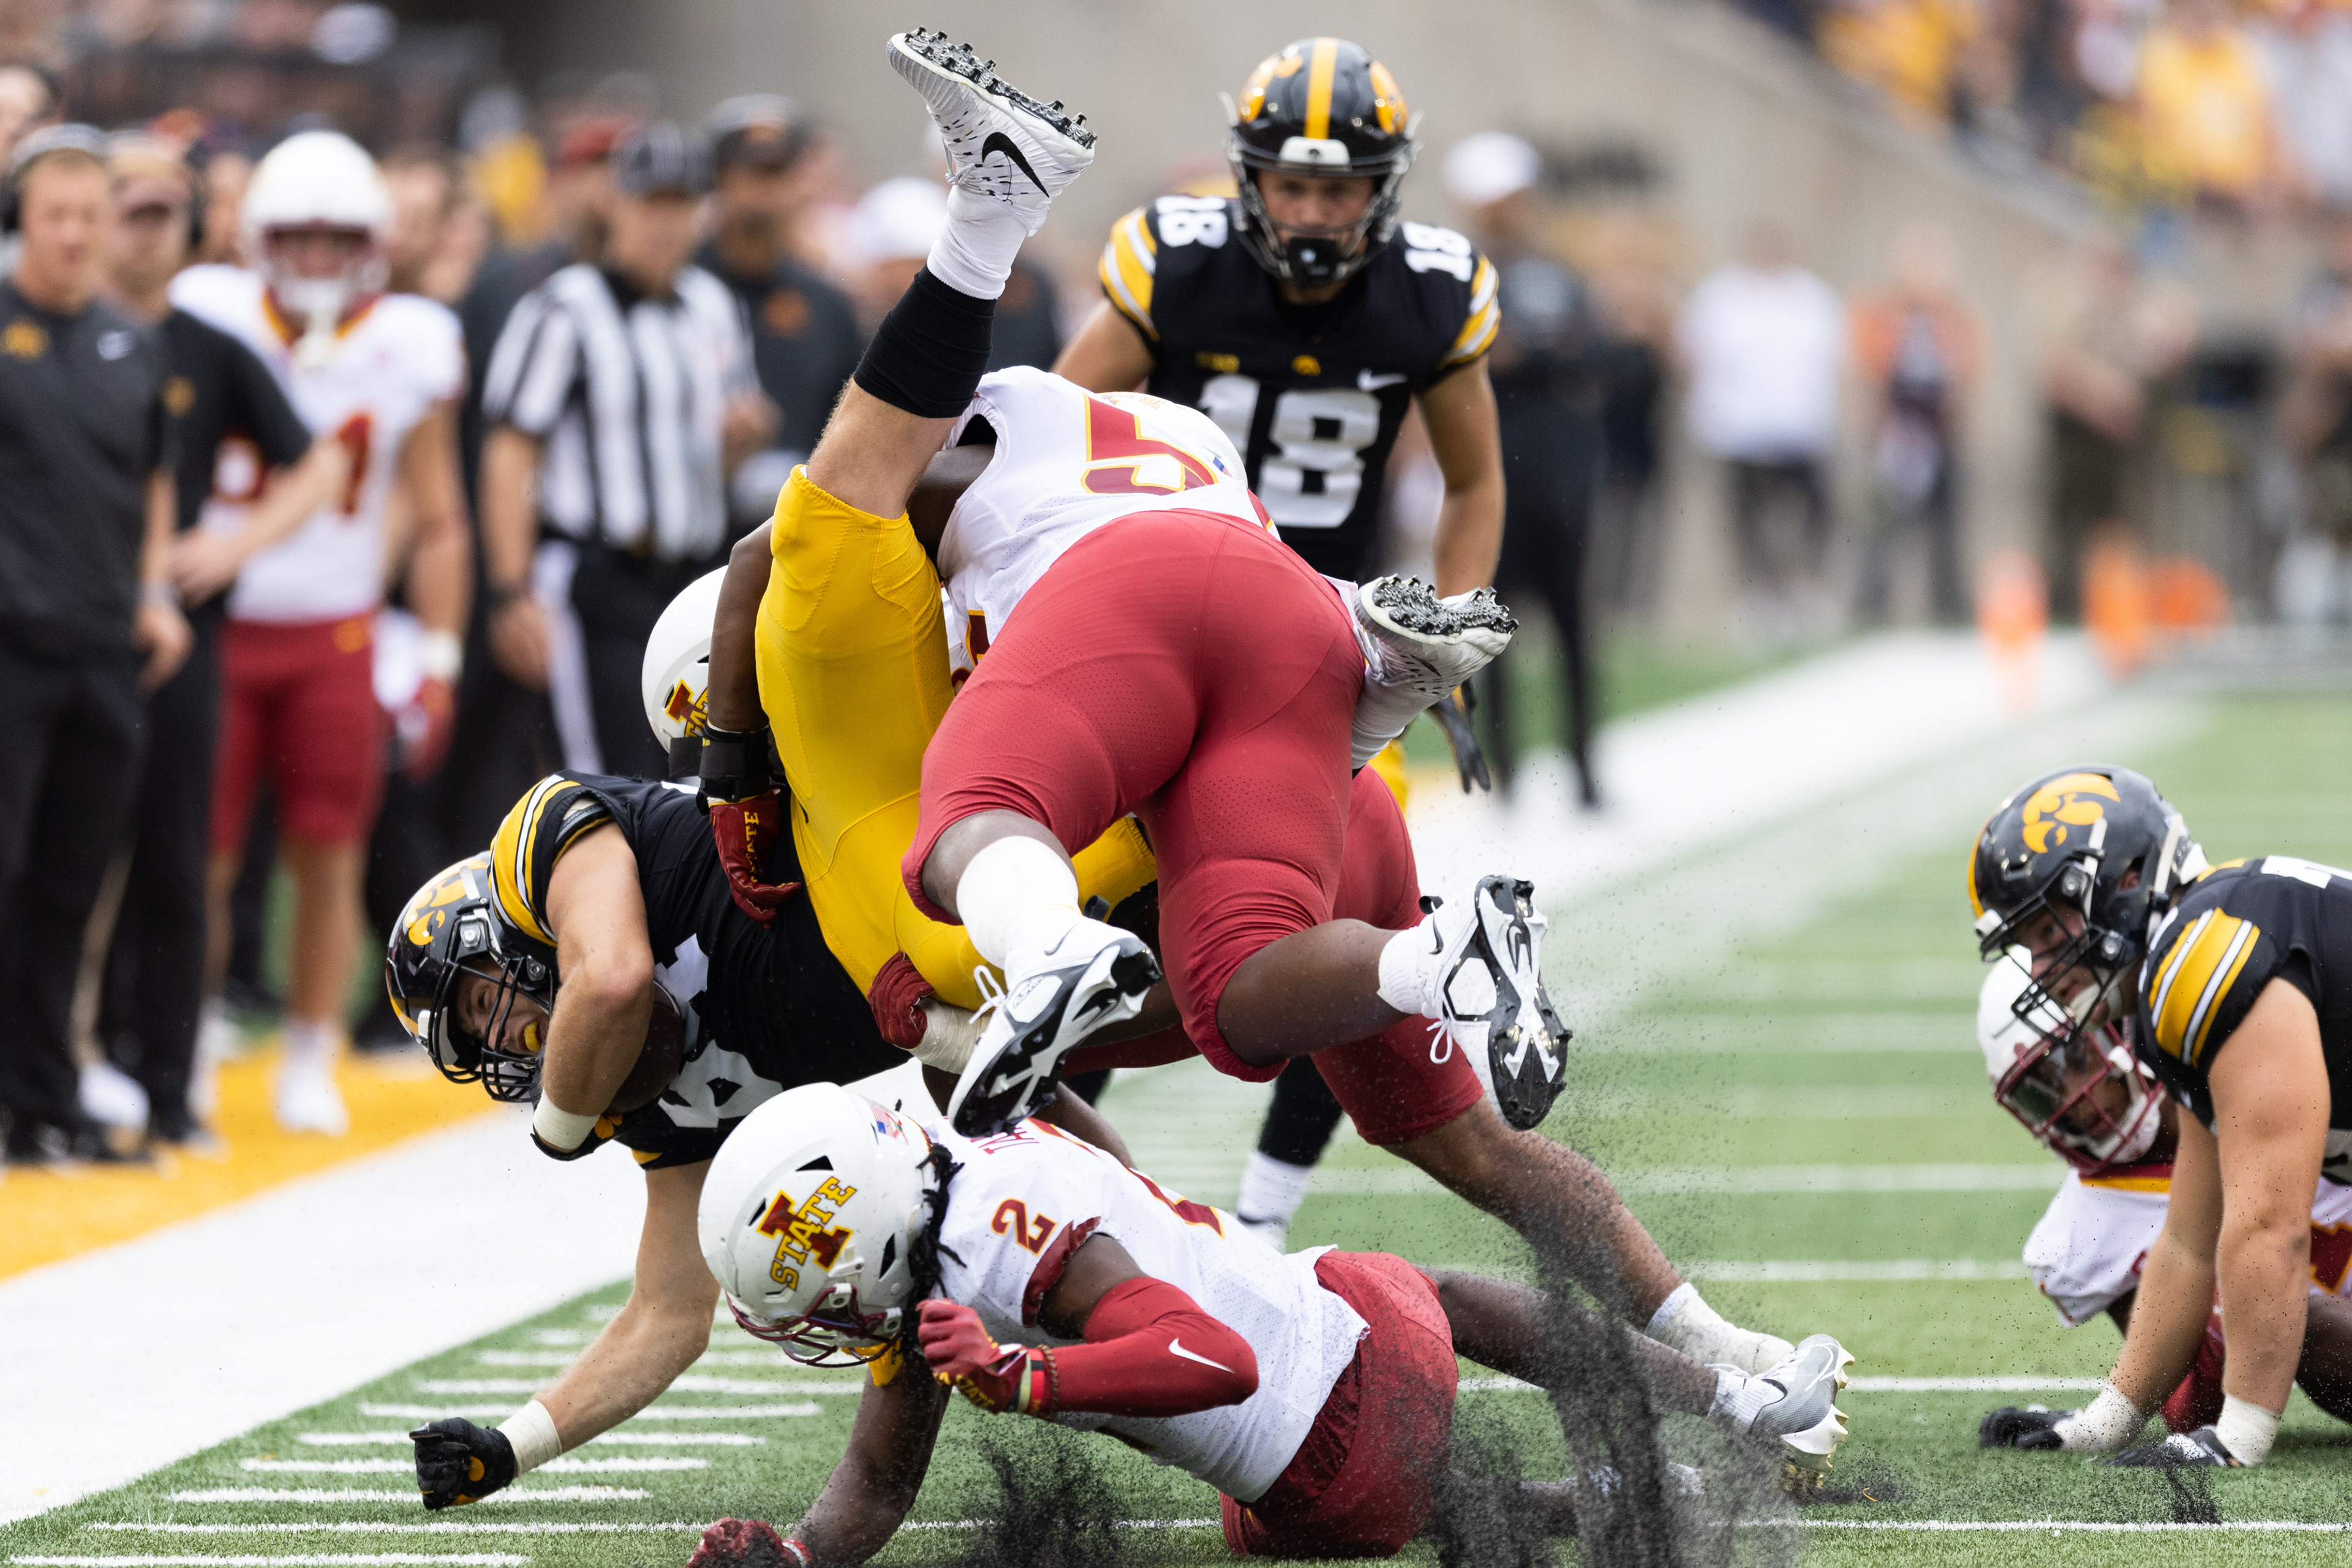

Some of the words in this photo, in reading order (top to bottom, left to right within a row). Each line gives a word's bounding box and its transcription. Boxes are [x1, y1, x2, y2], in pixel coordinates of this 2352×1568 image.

[1155, 195, 1227, 247] 18
[1402, 221, 1472, 282] 18
[1198, 374, 1382, 528] 18
[770, 1176, 858, 1291] STATE
[991, 1198, 1058, 1256] 2
